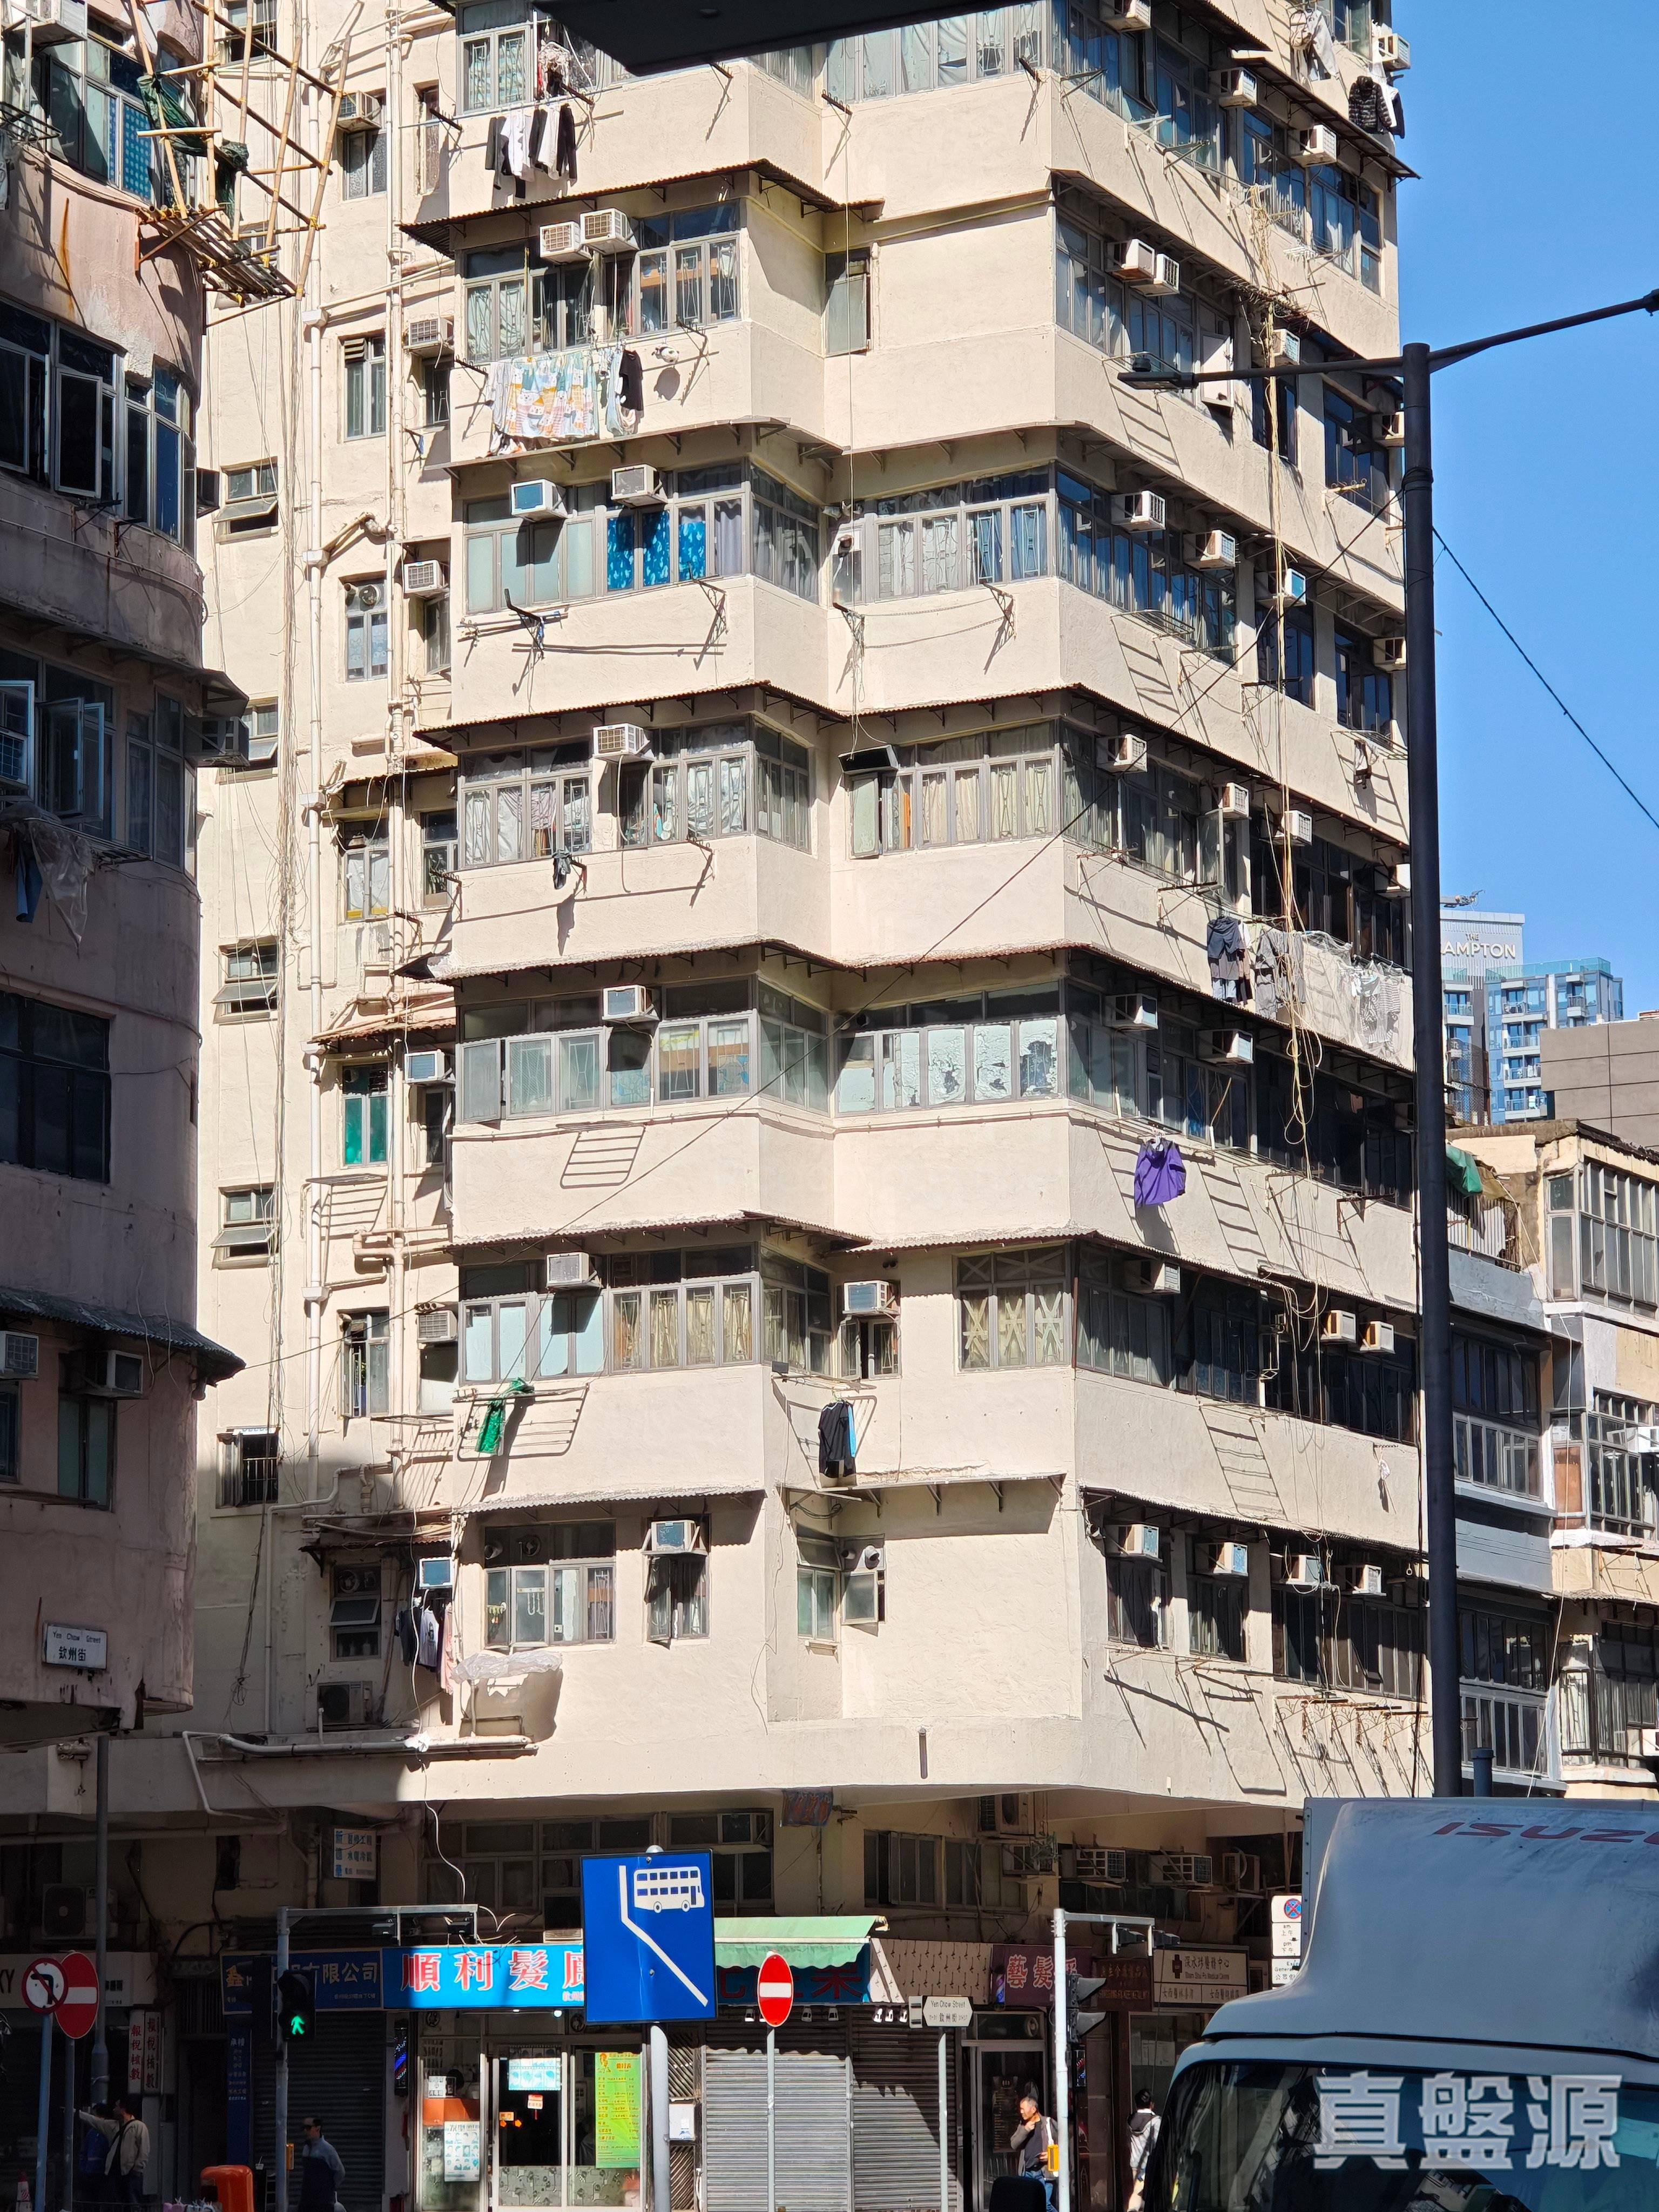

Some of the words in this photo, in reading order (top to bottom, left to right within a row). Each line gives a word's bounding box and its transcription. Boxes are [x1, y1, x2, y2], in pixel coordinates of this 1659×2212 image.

[1441, 941, 1516, 959] AMPTON
[59, 1646, 86, 1661] 欽州街
[1433, 1822, 1659, 1845] ISUZ
[1313, 2069, 1623, 2169] 真盤源
